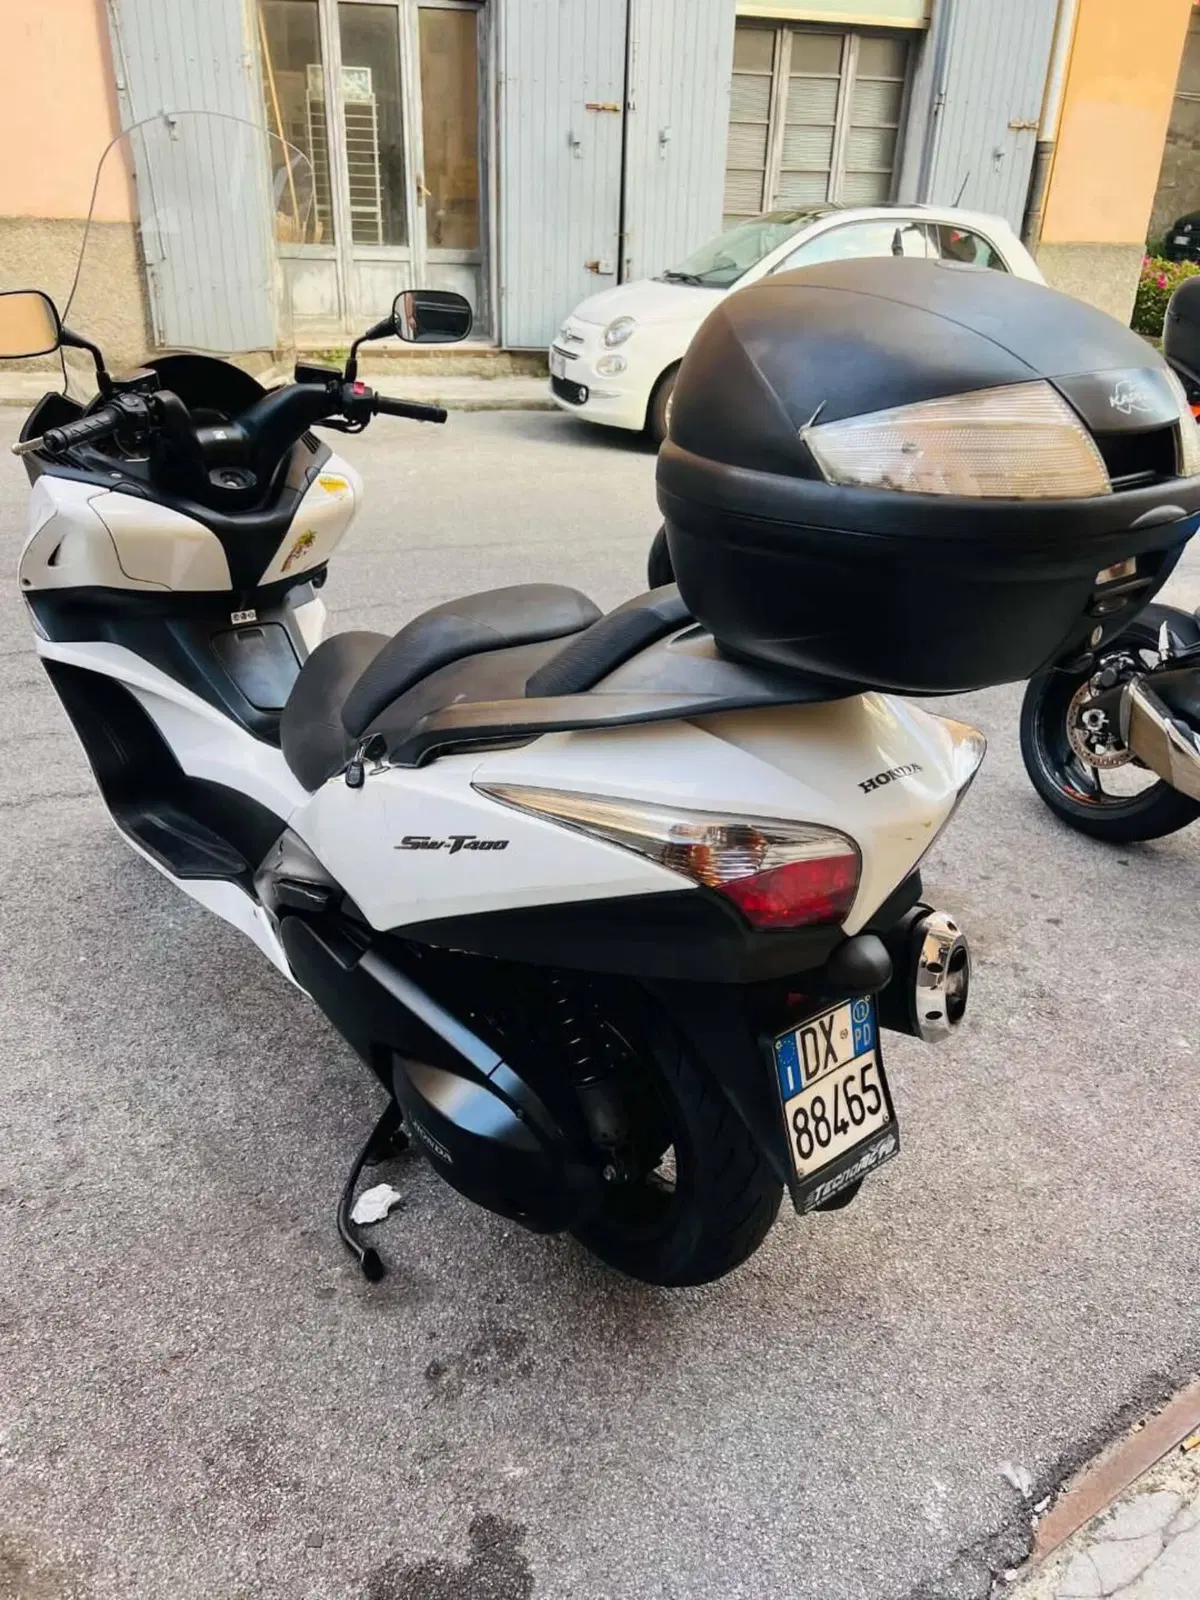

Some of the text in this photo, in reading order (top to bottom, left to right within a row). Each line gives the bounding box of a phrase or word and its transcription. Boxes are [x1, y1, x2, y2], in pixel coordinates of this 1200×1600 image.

[857, 762, 923, 795] HONDA
[800, 1014, 839, 1082] DX
[854, 1026, 872, 1050] PD
[786, 1065, 795, 1092] I
[792, 1062, 882, 1160] 88465
